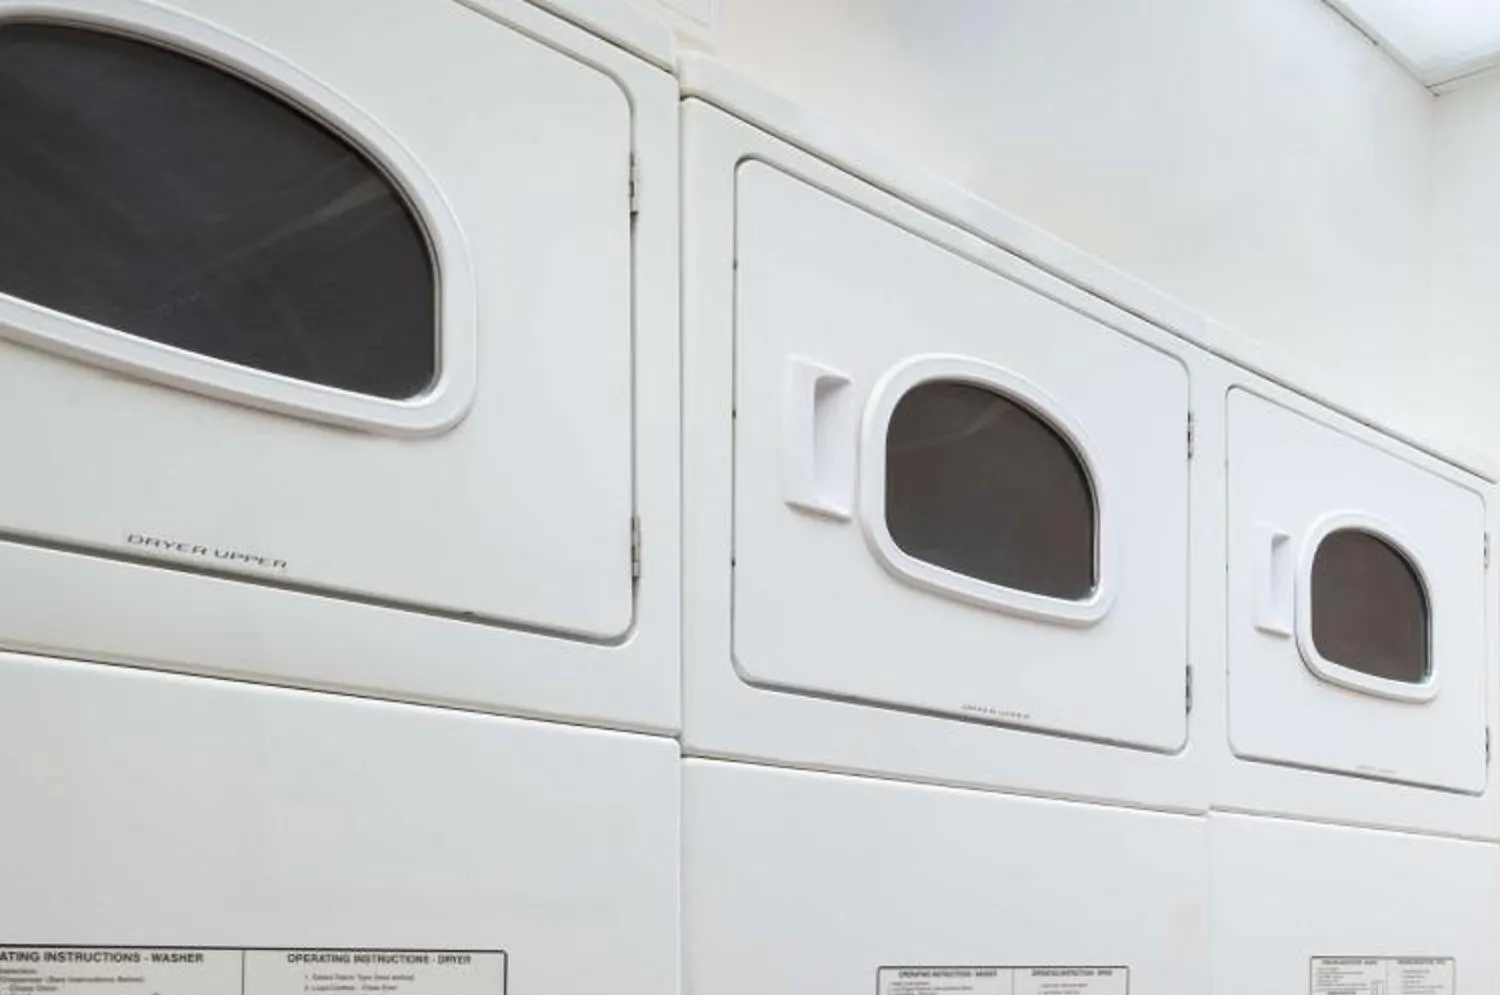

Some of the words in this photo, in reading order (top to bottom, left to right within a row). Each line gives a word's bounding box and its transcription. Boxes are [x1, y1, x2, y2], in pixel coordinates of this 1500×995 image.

[43, 951, 141, 964] INSTRUCTIONS
[151, 952, 204, 964] WASHER
[287, 953, 350, 965] OPERATING
[353, 954, 429, 965] INSTRUCTIONS
